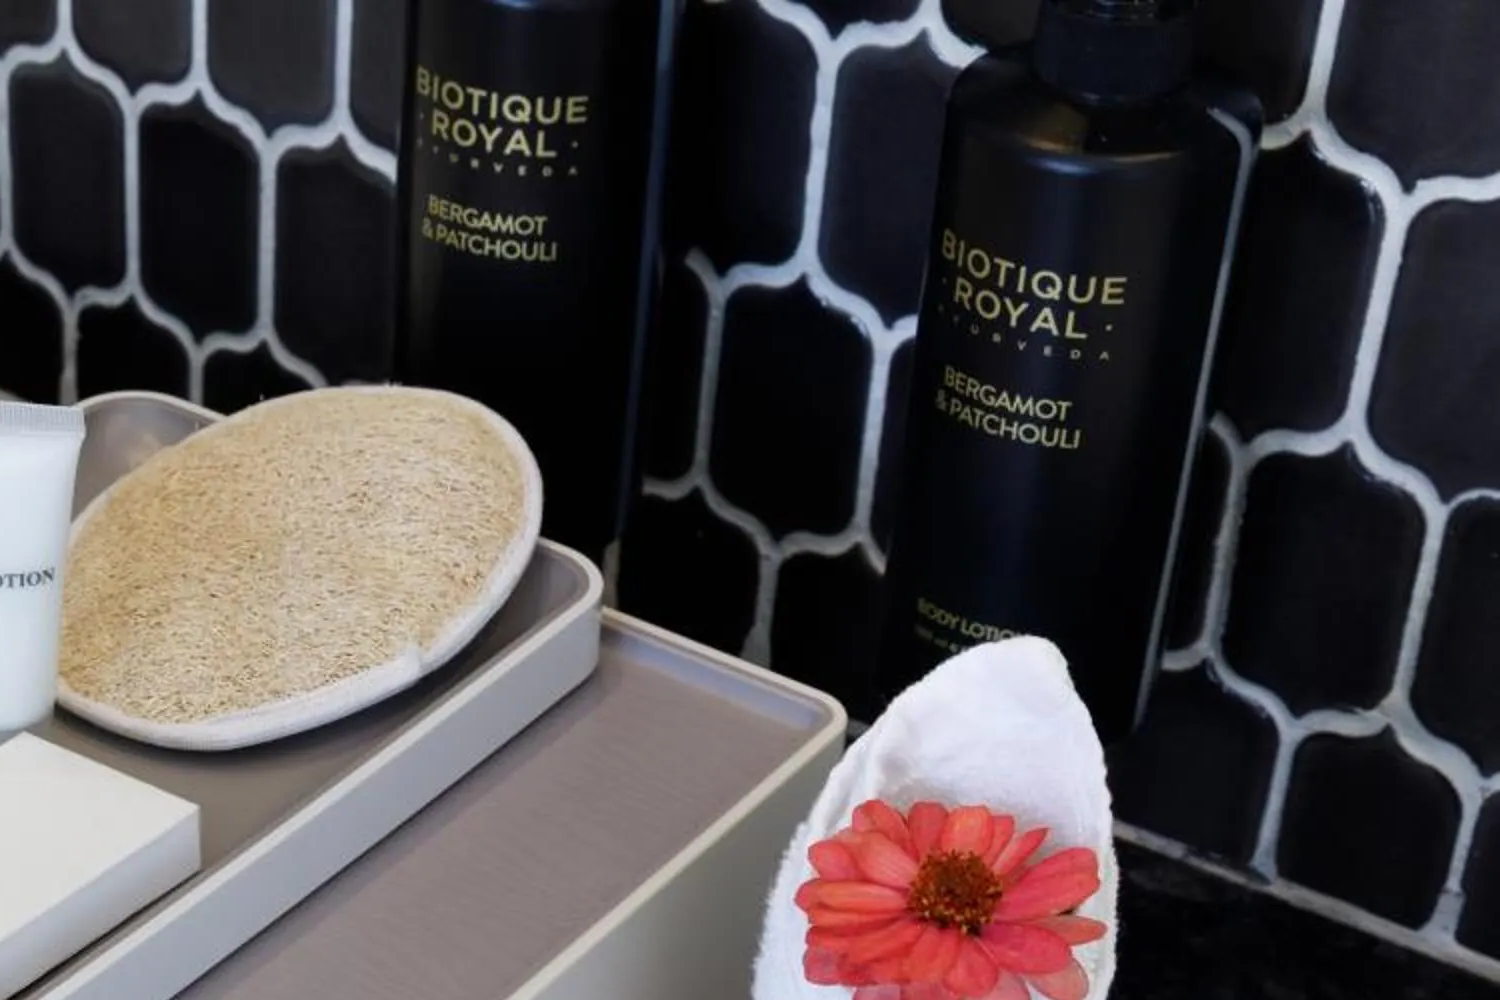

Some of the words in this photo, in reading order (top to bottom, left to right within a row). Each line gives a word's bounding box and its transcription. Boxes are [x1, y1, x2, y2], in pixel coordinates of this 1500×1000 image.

[416, 64, 589, 124] BIOTIQUE
[431, 107, 557, 158] ROYAL
[427, 193, 548, 236] BERGAMOT
[941, 228, 1128, 305] BIOTIQUE
[953, 277, 1088, 339] ROYAL
[942, 364, 1073, 422] BERGAMOT
[959, 616, 1022, 641] LOTIO
